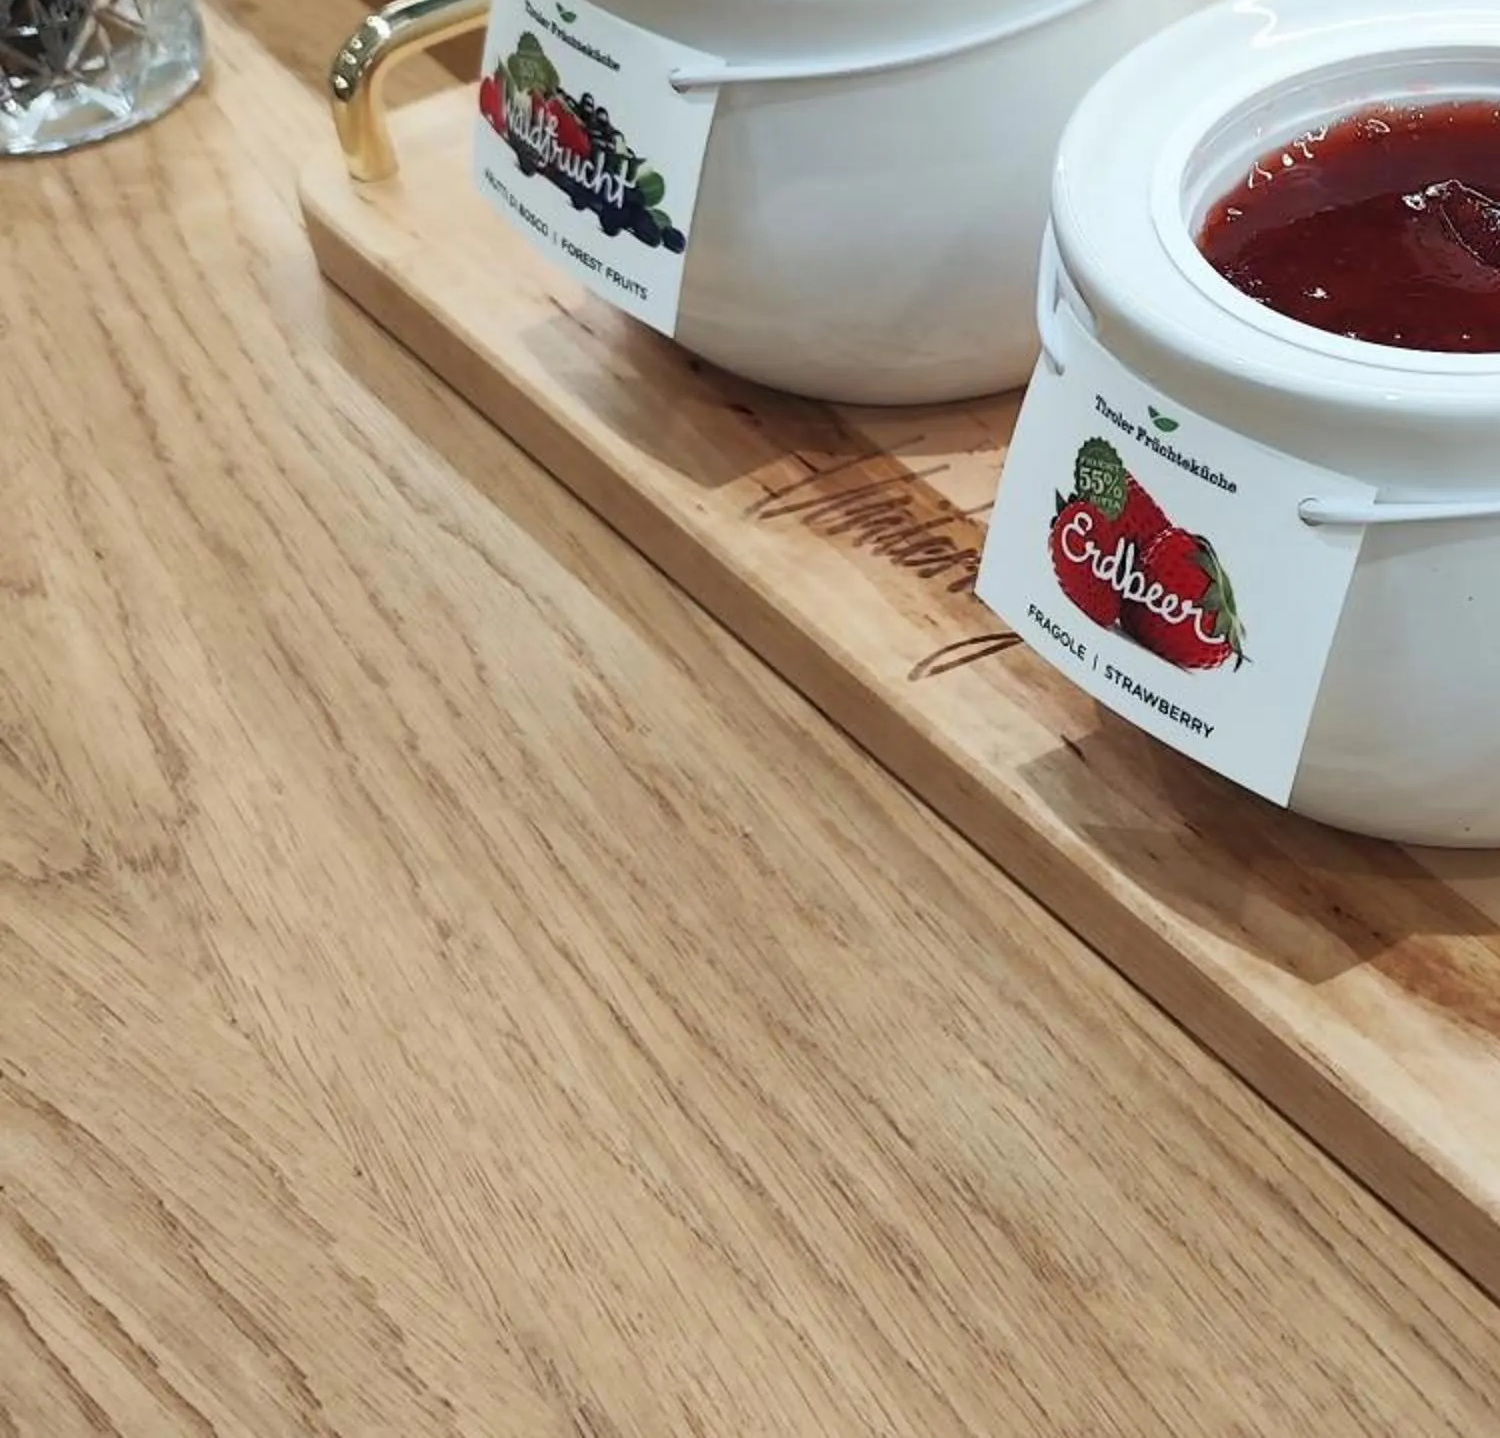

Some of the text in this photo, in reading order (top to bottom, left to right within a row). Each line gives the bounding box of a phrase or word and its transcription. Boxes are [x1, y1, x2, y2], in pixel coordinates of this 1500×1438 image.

[561, 237, 603, 273] FOREST
[605, 267, 648, 300] FRUITS
[1079, 466, 1123, 499] 55%
[1095, 394, 1238, 495] Tiroler Früchteküche
[1061, 510, 1226, 645] Erdbeer
[1026, 603, 1088, 662] FRAGOLE
[1104, 665, 1216, 739] STRAWBERRY
